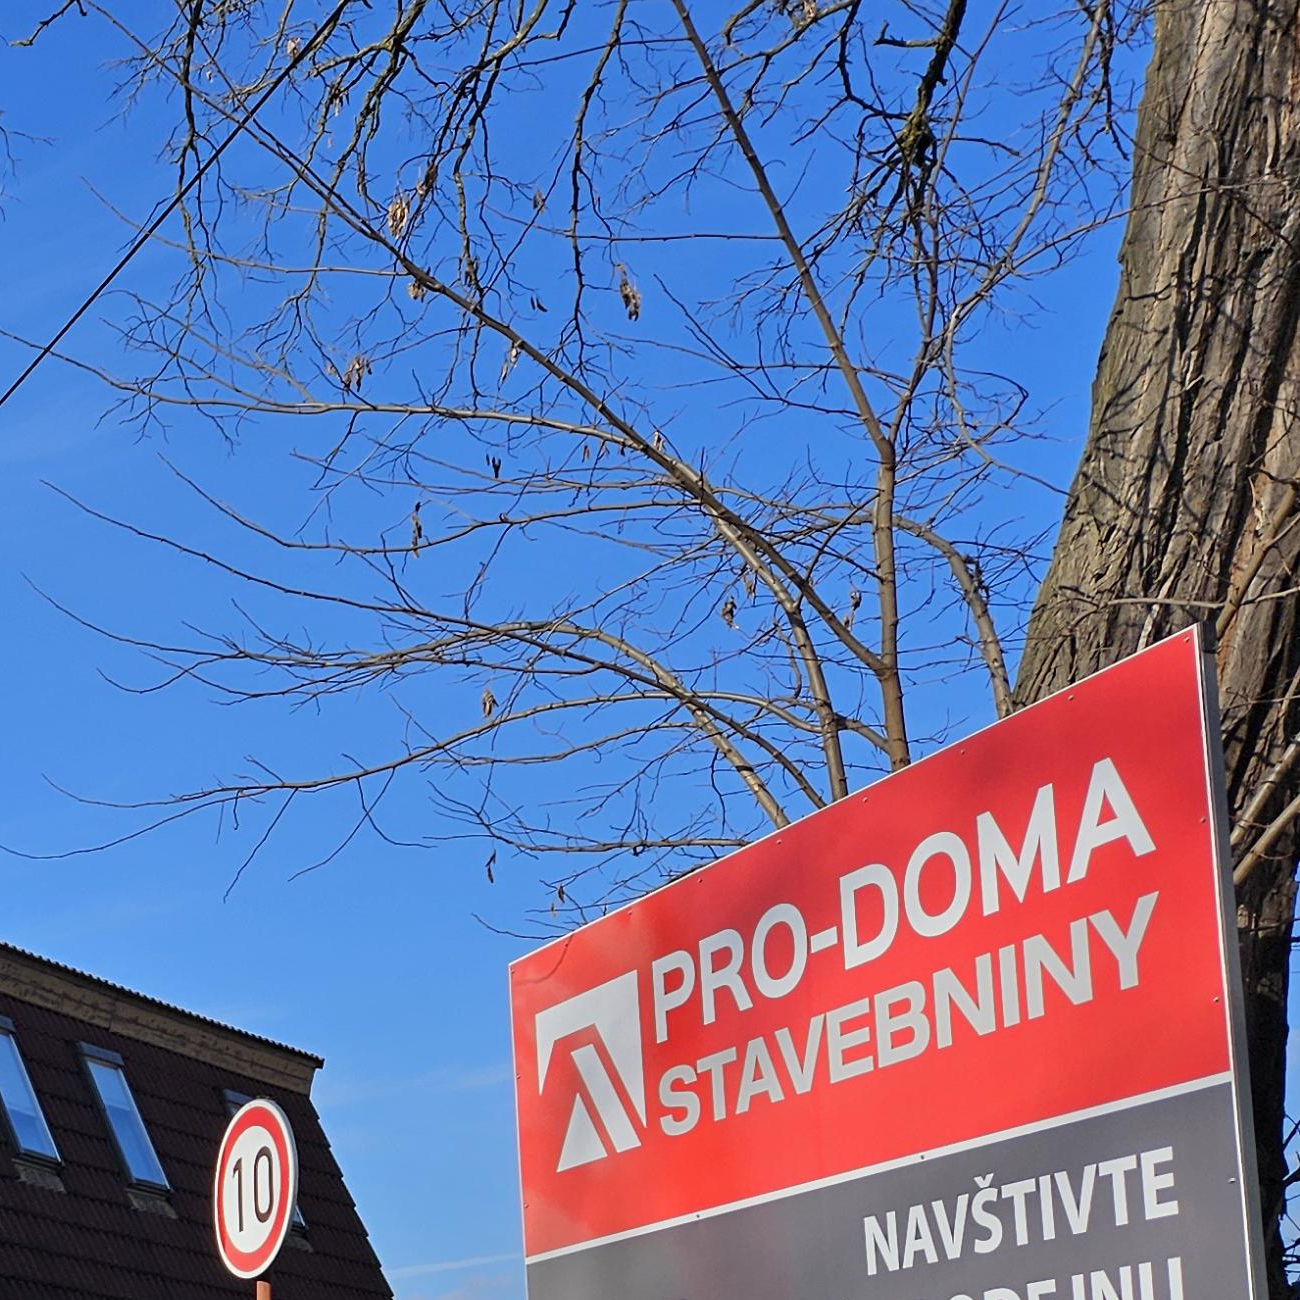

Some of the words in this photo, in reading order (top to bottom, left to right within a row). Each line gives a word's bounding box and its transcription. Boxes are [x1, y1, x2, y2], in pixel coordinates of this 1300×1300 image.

[652, 757, 1157, 1044] PRO-DOMA
[659, 892, 1160, 1137] STAVEBNINY
[232, 1145, 274, 1233] 10
[864, 1146, 1179, 1276] NAVŠTIVTE
